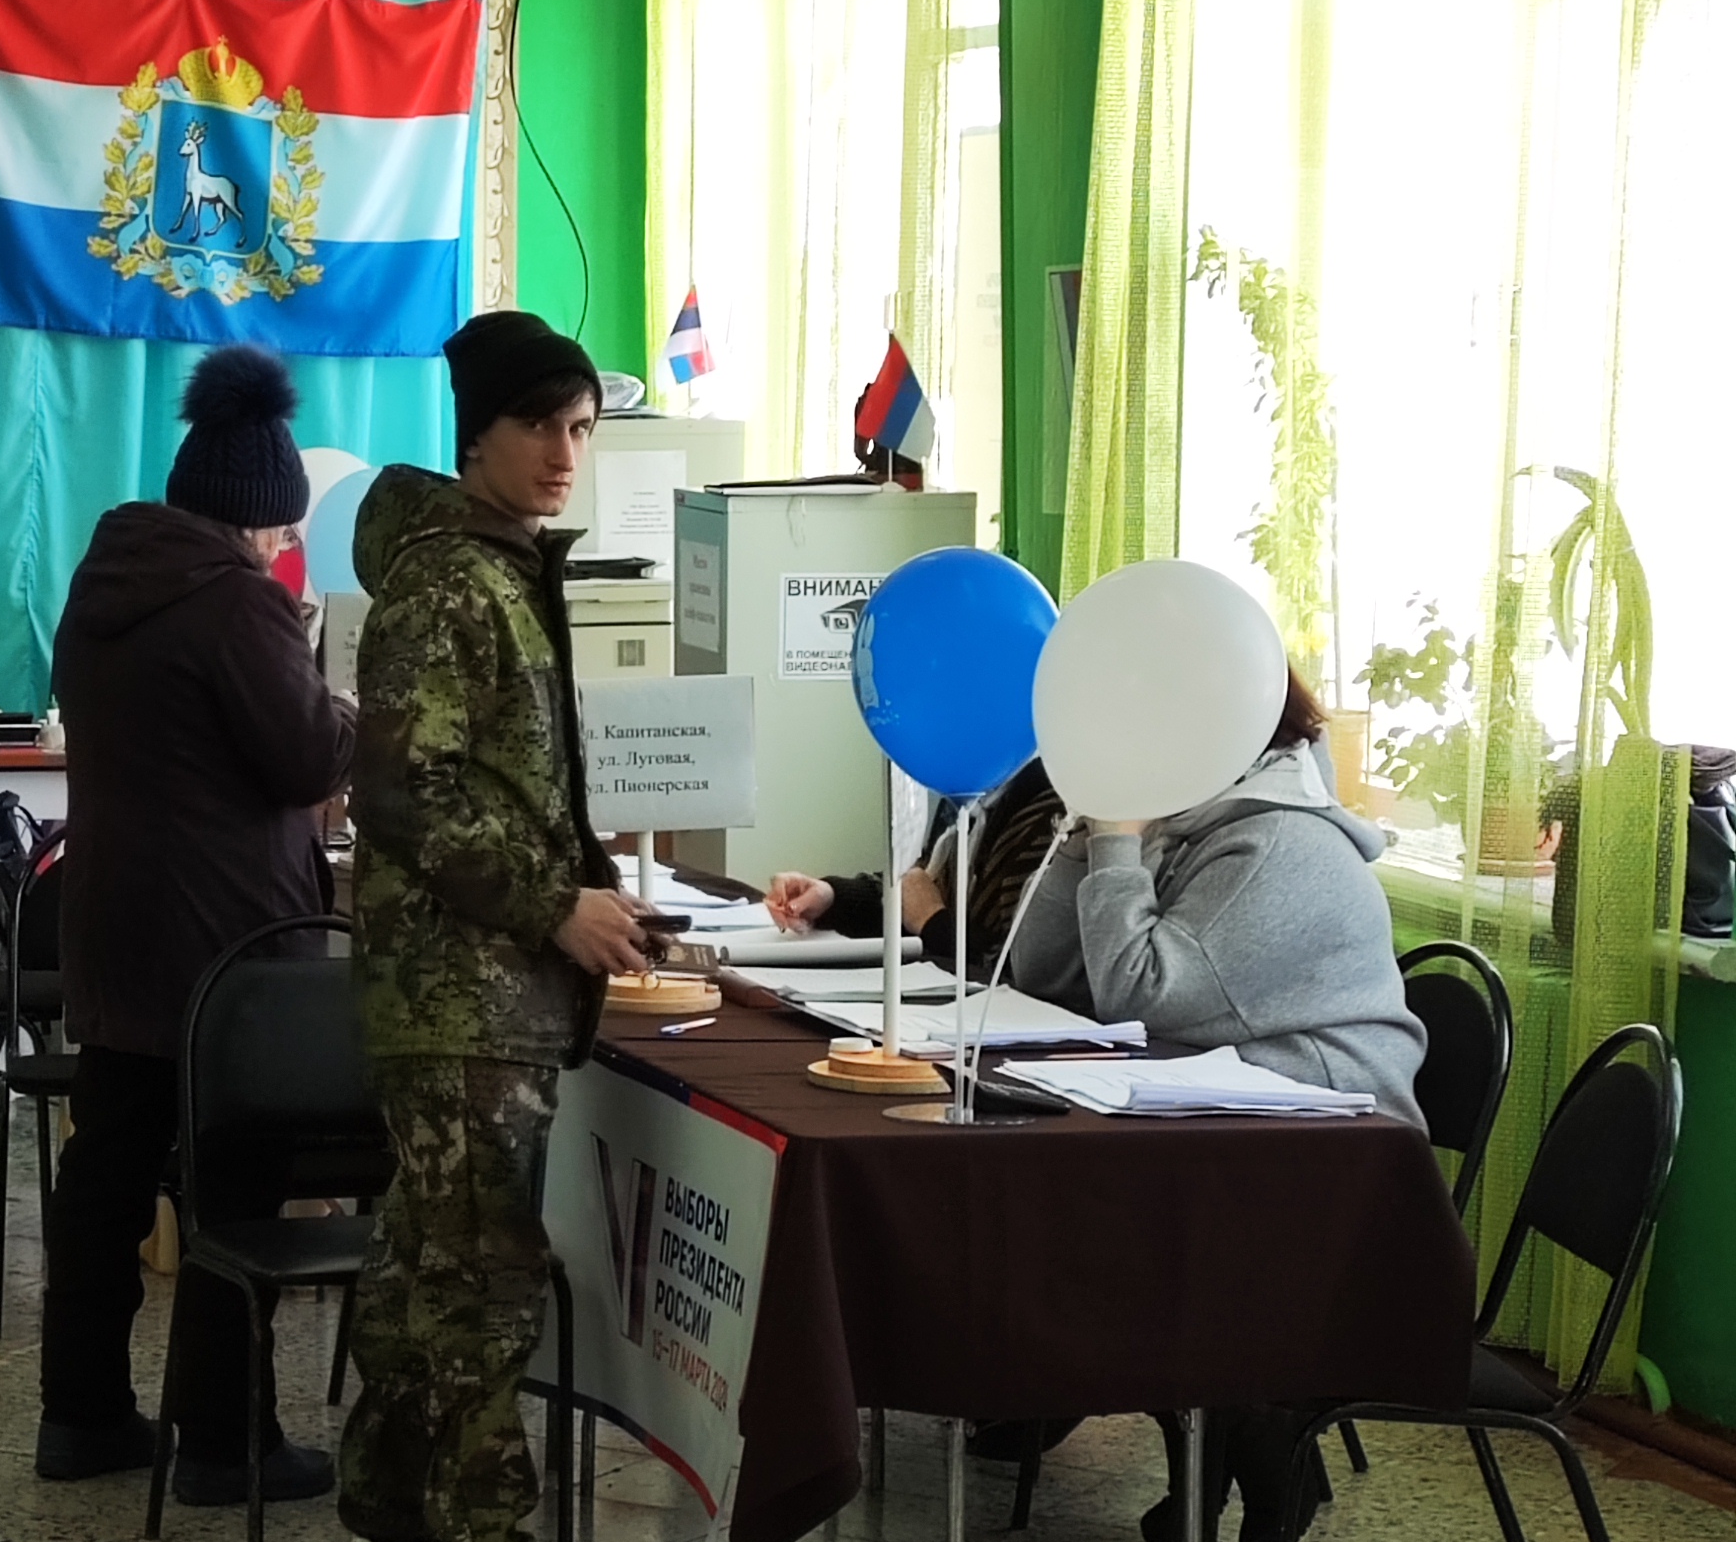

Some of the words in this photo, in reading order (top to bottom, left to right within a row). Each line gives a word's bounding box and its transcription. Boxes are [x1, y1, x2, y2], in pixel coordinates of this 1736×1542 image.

[787, 580, 883, 596] ВНИМАН
[796, 650, 852, 660] ПОМЕЩЕН
[604, 724, 711, 740] Капитанская,
[597, 756, 620, 770] ул.
[625, 751, 695, 768] Луговая,
[614, 779, 709, 795] Пионерская
[665, 1176, 729, 1246] ВЫБОРЫ
[659, 1227, 745, 1316] ПРЕЗИДЕНТА
[654, 1278, 711, 1347] РОССИИ
